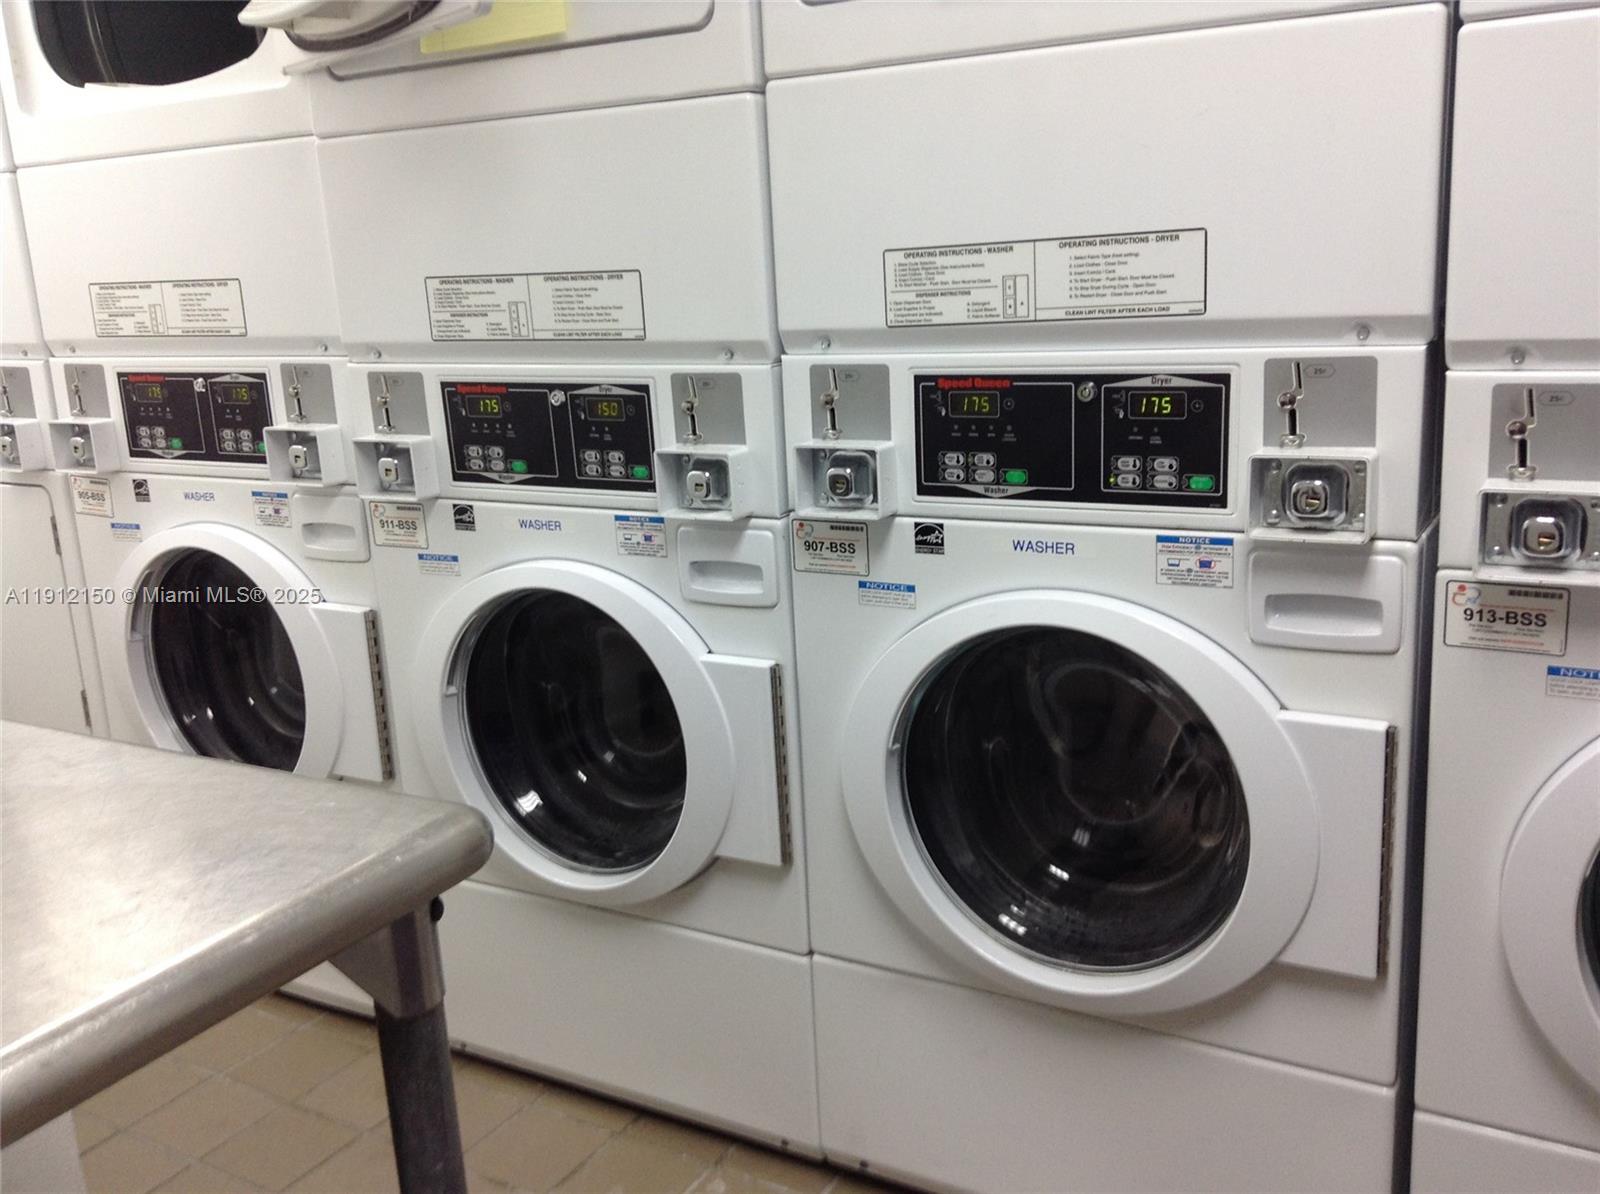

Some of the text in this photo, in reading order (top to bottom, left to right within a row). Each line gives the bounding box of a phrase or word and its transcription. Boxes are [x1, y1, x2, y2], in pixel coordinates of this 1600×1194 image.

[1059, 239, 1097, 249] OPERATING
[1099, 236, 1150, 247] INSTRUCTIONS
[1155, 234, 1180, 242] DRYER
[903, 250, 938, 260] OPERATING
[938, 247, 983, 258] INSTRUCTIONS
[987, 246, 1014, 254] WASHER
[937, 378, 1010, 388] Speed Queen
[1151, 376, 1172, 386] Dryer
[233, 388, 248, 400] 175
[480, 400, 499, 412] 175
[597, 403, 618, 416] 150
[963, 396, 990, 412] 175
[1141, 397, 1171, 414] 175
[183, 491, 215, 502] WASHER
[983, 486, 1009, 495] Washer
[379, 519, 417, 531] 911-BSS
[518, 518, 562, 531] WASHER
[804, 540, 856, 554] 907-BSS
[1012, 539, 1075, 555] WASHER
[866, 582, 906, 591] NOTICE
[1463, 608, 1547, 627] 913-BSS
